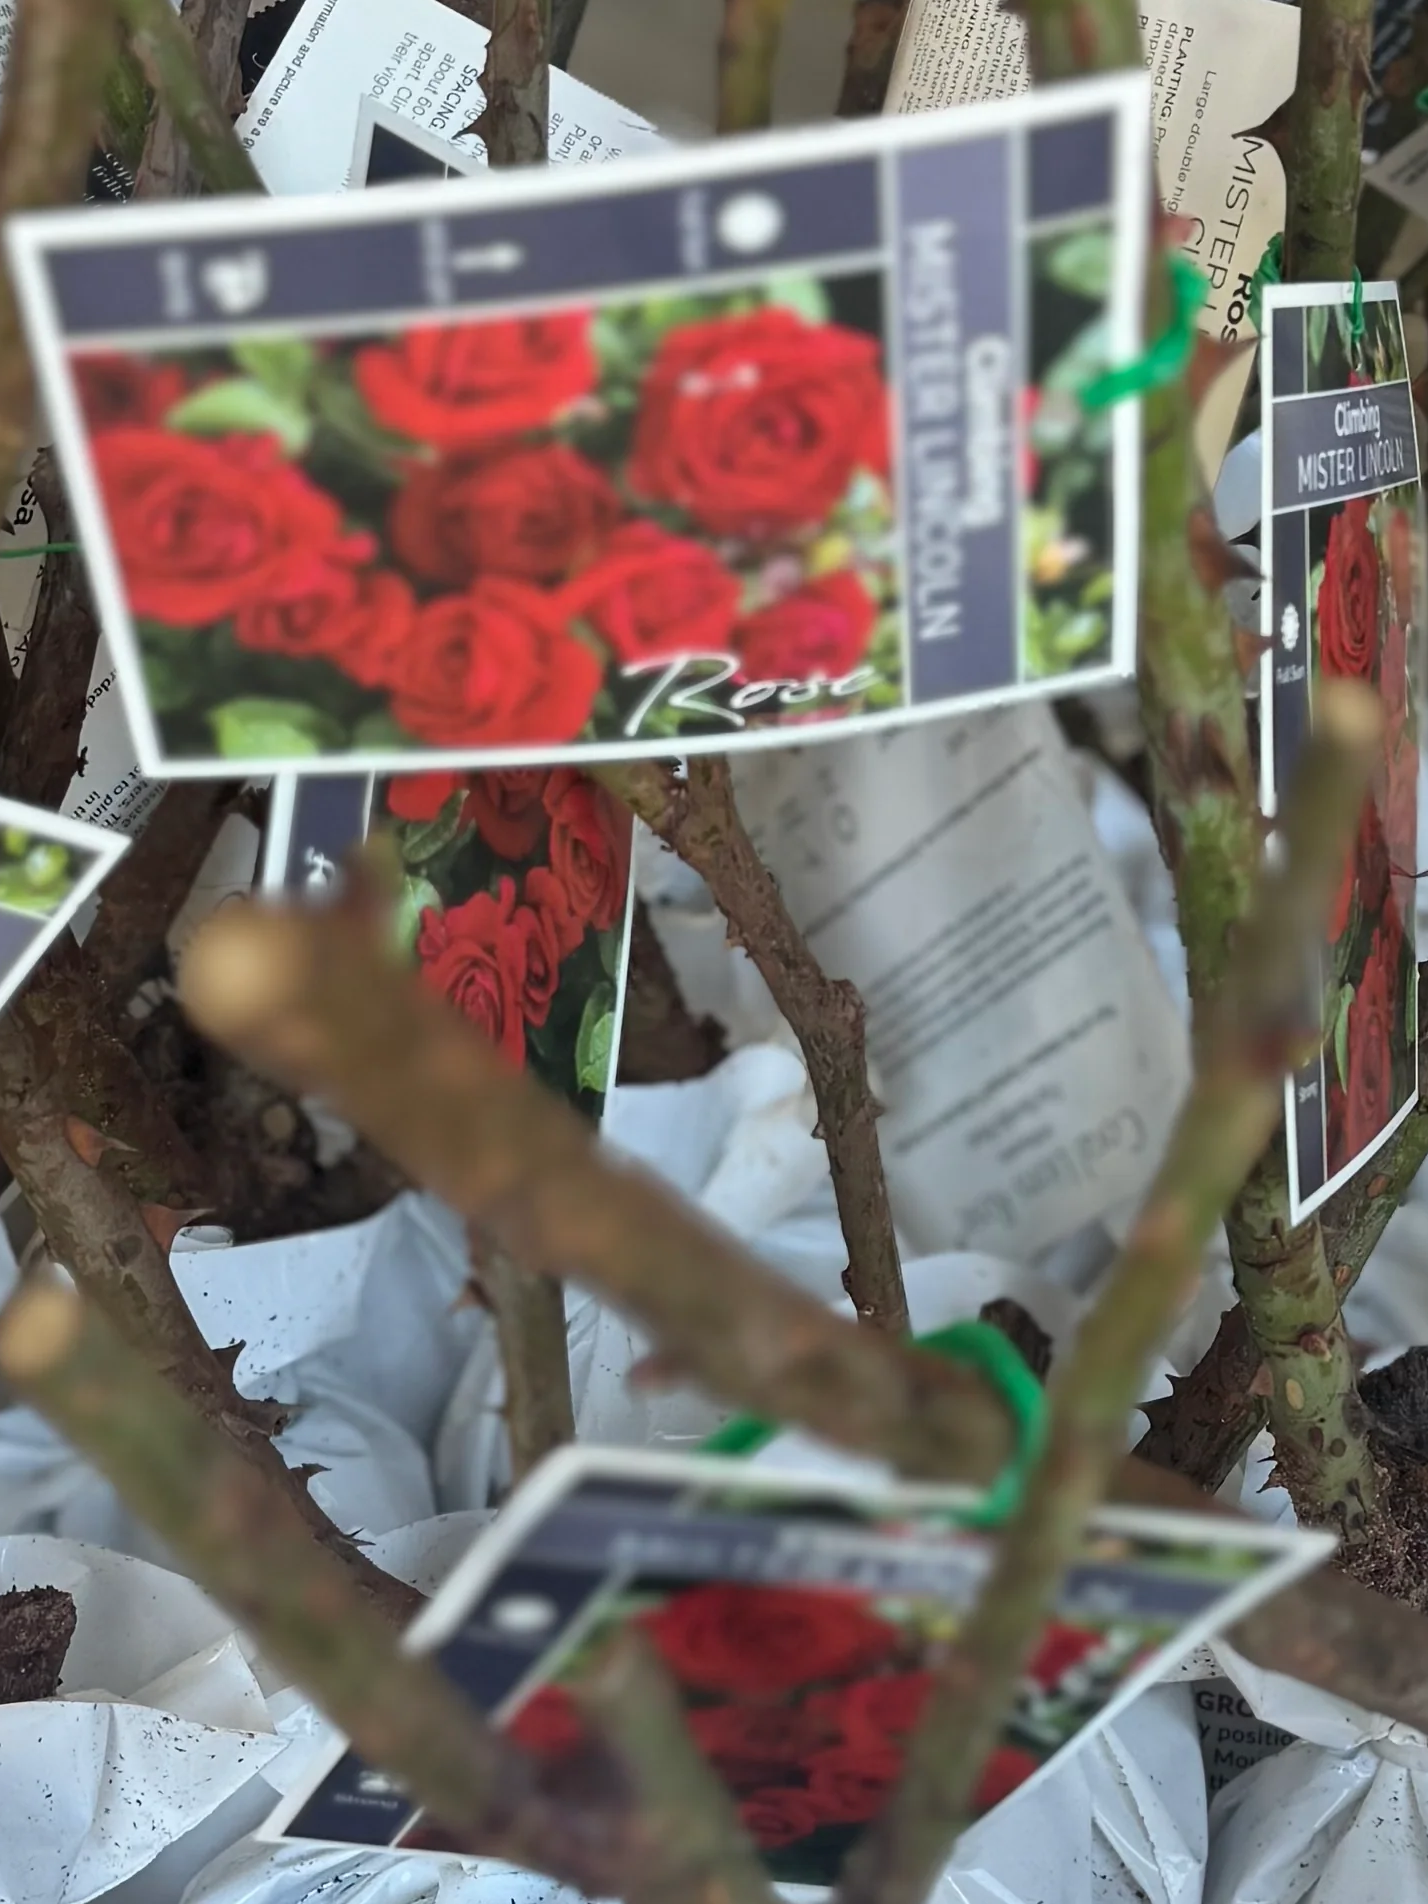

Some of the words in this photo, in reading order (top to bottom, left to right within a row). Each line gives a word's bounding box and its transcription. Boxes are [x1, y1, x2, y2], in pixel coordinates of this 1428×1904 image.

[289, 42, 312, 68] and
[389, 29, 418, 66] their
[425, 51, 457, 96] about
[1157, 23, 1194, 125] PLANTING:
[266, 65, 297, 107] picture
[1193, 68, 1217, 121] Large
[255, 105, 274, 127] are
[1176, 121, 1202, 184] double
[1202, 136, 1263, 292] MISTER
[900, 219, 957, 422] MISTER
[1334, 400, 1381, 438] Climbing
[1298, 447, 1355, 493] MISTER
[1358, 436, 1404, 481] LINCOLN
[912, 426, 961, 645] LINCOLN
[620, 647, 884, 739] Rose
